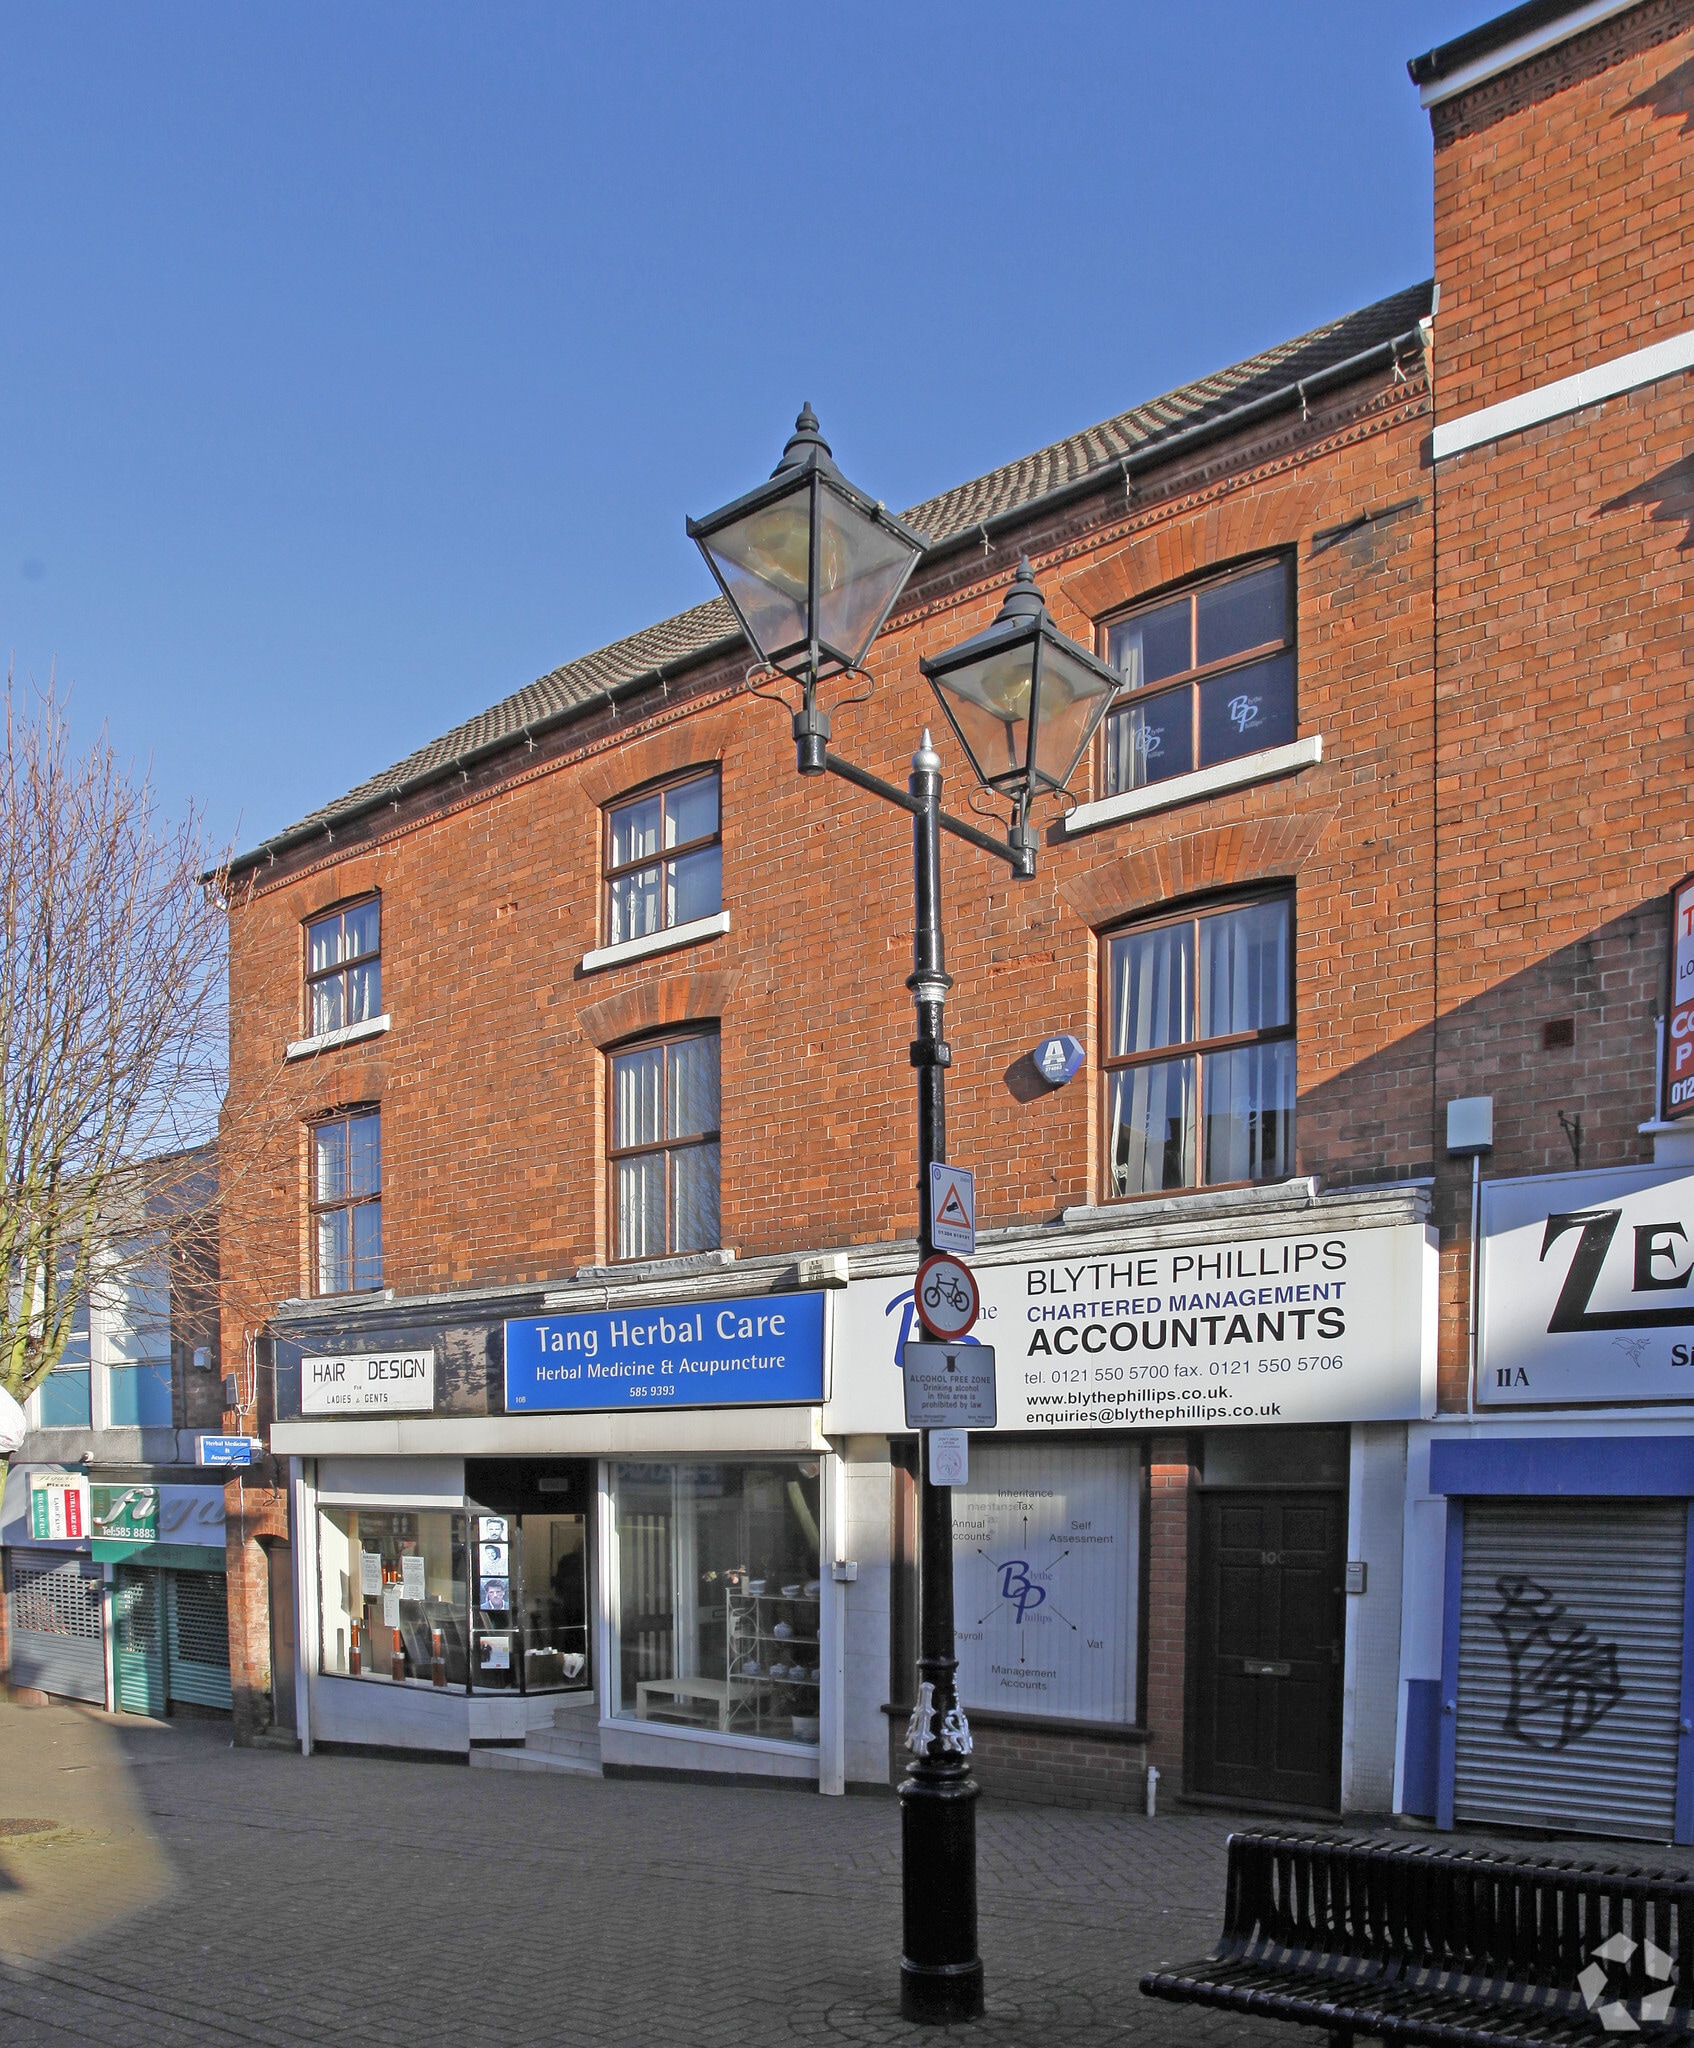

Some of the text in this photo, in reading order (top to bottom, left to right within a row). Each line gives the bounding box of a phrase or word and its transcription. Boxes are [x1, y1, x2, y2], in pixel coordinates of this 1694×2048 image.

[1027, 1240, 1347, 1296] BLYTHE PHILLIPS
[1027, 1296, 1162, 1323] CHARTERED
[1169, 1281, 1347, 1312] MANAGEMENT
[535, 1310, 786, 1357] Tang Herbal Care
[1026, 1306, 1346, 1357] ACCOUNTANTS
[313, 1358, 425, 1383] HAIR DESIGN
[536, 1354, 786, 1381] Herbal Medicine & Acupuncture
[1025, 1355, 1343, 1384] tel. 0121 550 5700 fax. 0121 550 5706
[910, 1375, 947, 1383] ALCOHOL
[971, 1376, 991, 1384] ZONE
[1497, 1367, 1530, 1388] 11A
[629, 1385, 675, 1398] 585 9393
[923, 1384, 953, 1392] Drinking
[326, 1394, 351, 1404] LADIES
[364, 1393, 388, 1403] GENTS
[1026, 1386, 1233, 1407] www.blythephillips.co.uk.
[921, 1401, 957, 1409] prohibited
[1026, 1403, 1282, 1425] enquiries@blythephillips.co.uk
[997, 1488, 1054, 1498] Inheritance
[1017, 1501, 1034, 1511] Tax
[952, 1519, 985, 1528] Annual
[1071, 1520, 1092, 1530] Self
[133, 1528, 156, 1538] 8883
[952, 1532, 991, 1541] ccounts
[1049, 1534, 1114, 1544] Assessment
[1261, 1551, 1286, 1564] 10C
[1086, 1638, 1104, 1649] Vat
[991, 1664, 1057, 1678] Management
[1000, 1679, 1047, 1690] Accounts
